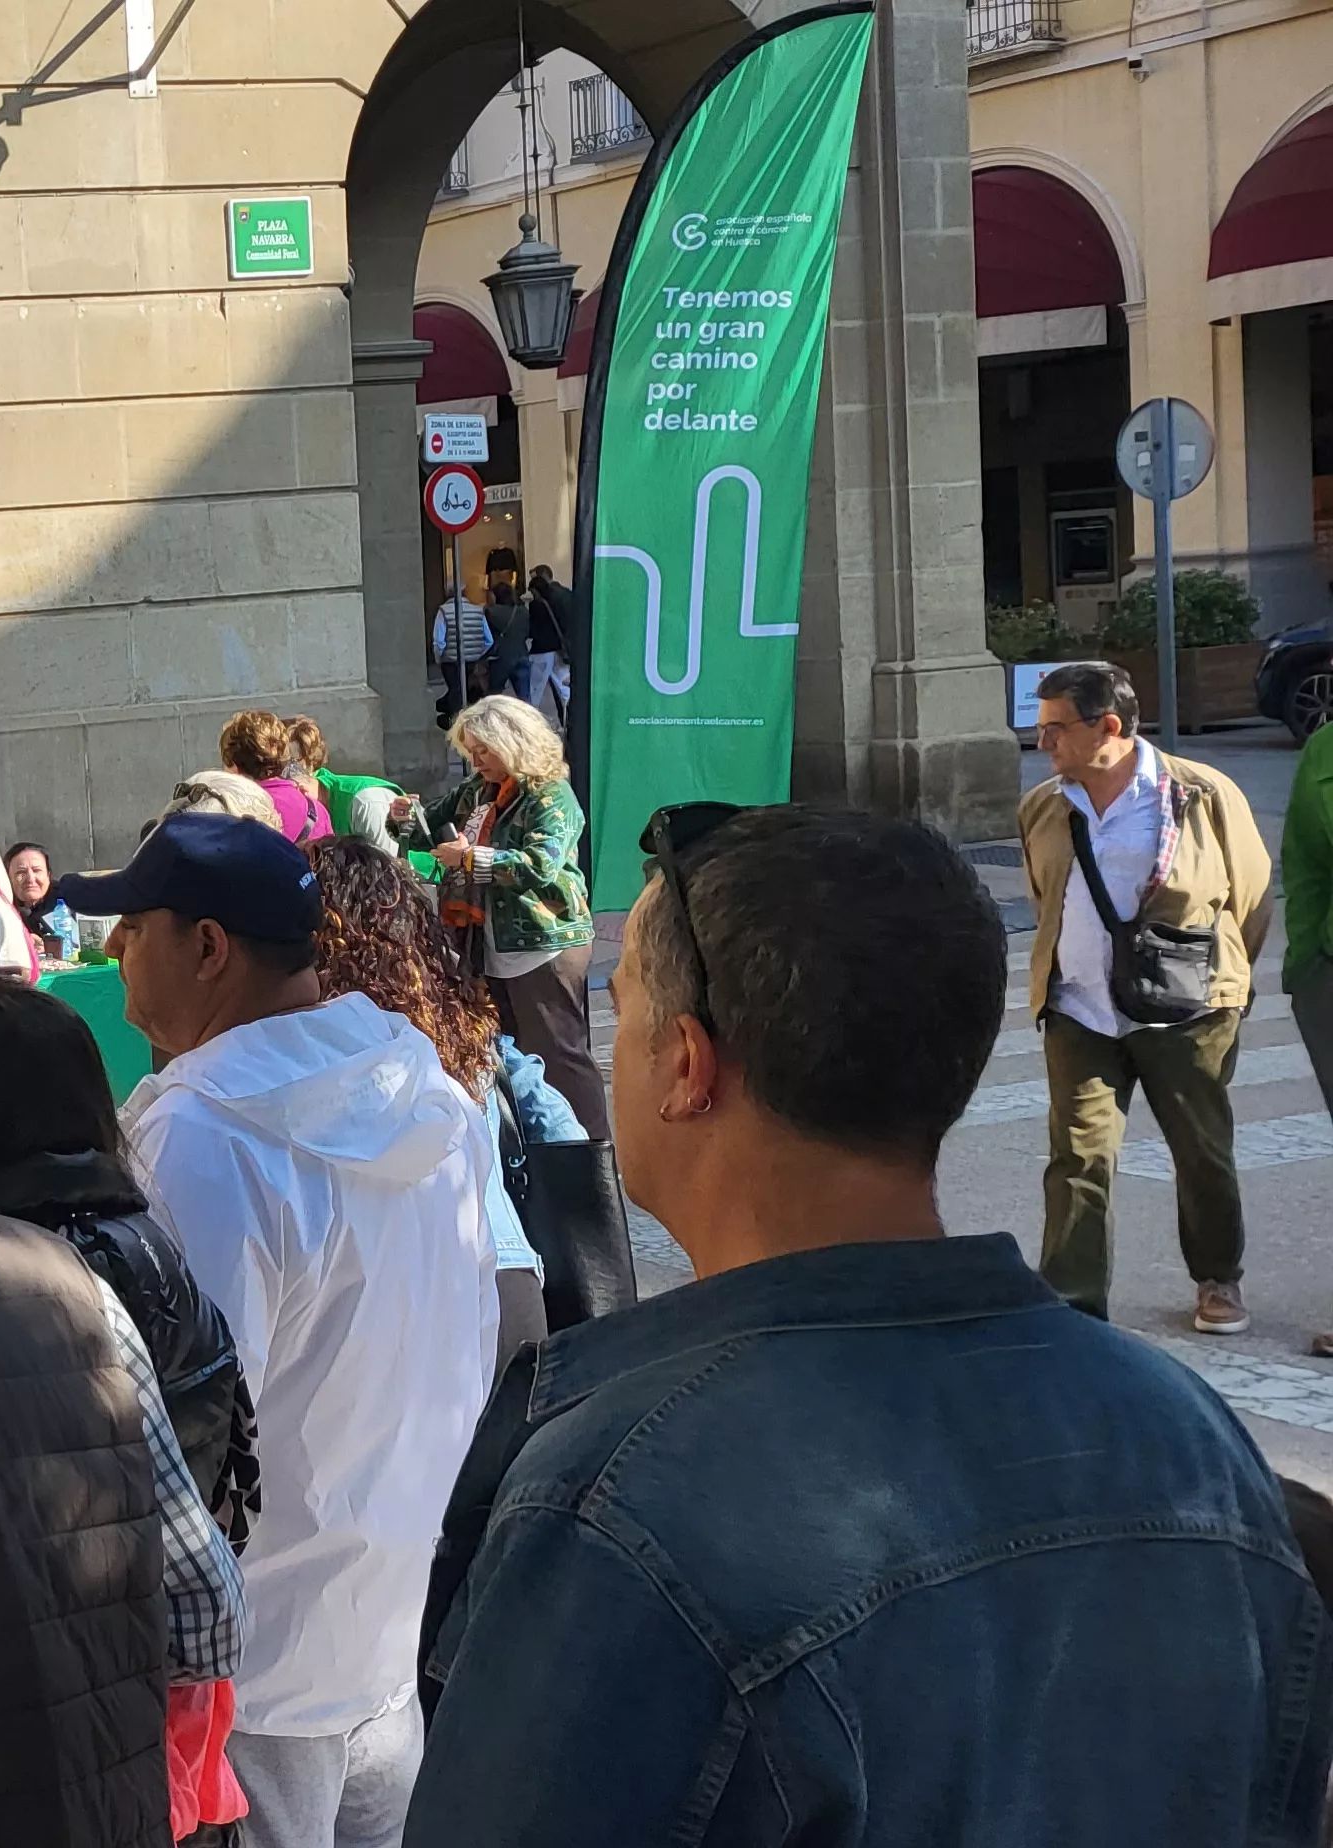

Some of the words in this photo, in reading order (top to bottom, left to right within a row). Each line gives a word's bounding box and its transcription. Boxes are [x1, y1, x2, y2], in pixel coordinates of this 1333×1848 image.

[766, 212, 812, 225] española
[257, 220, 288, 231] PLAZA
[714, 227, 744, 236] contra
[251, 233, 295, 246] NAVARRA
[725, 237, 761, 247] Huesca
[282, 247, 299, 259] Foral
[662, 286, 793, 309] Tenemos
[655, 320, 691, 339] un
[698, 320, 765, 345] gran
[651, 346, 758, 370] camino
[646, 382, 697, 405] por
[644, 407, 758, 432] delante
[628, 716, 764, 726] asociacioncontraelcancer.es
